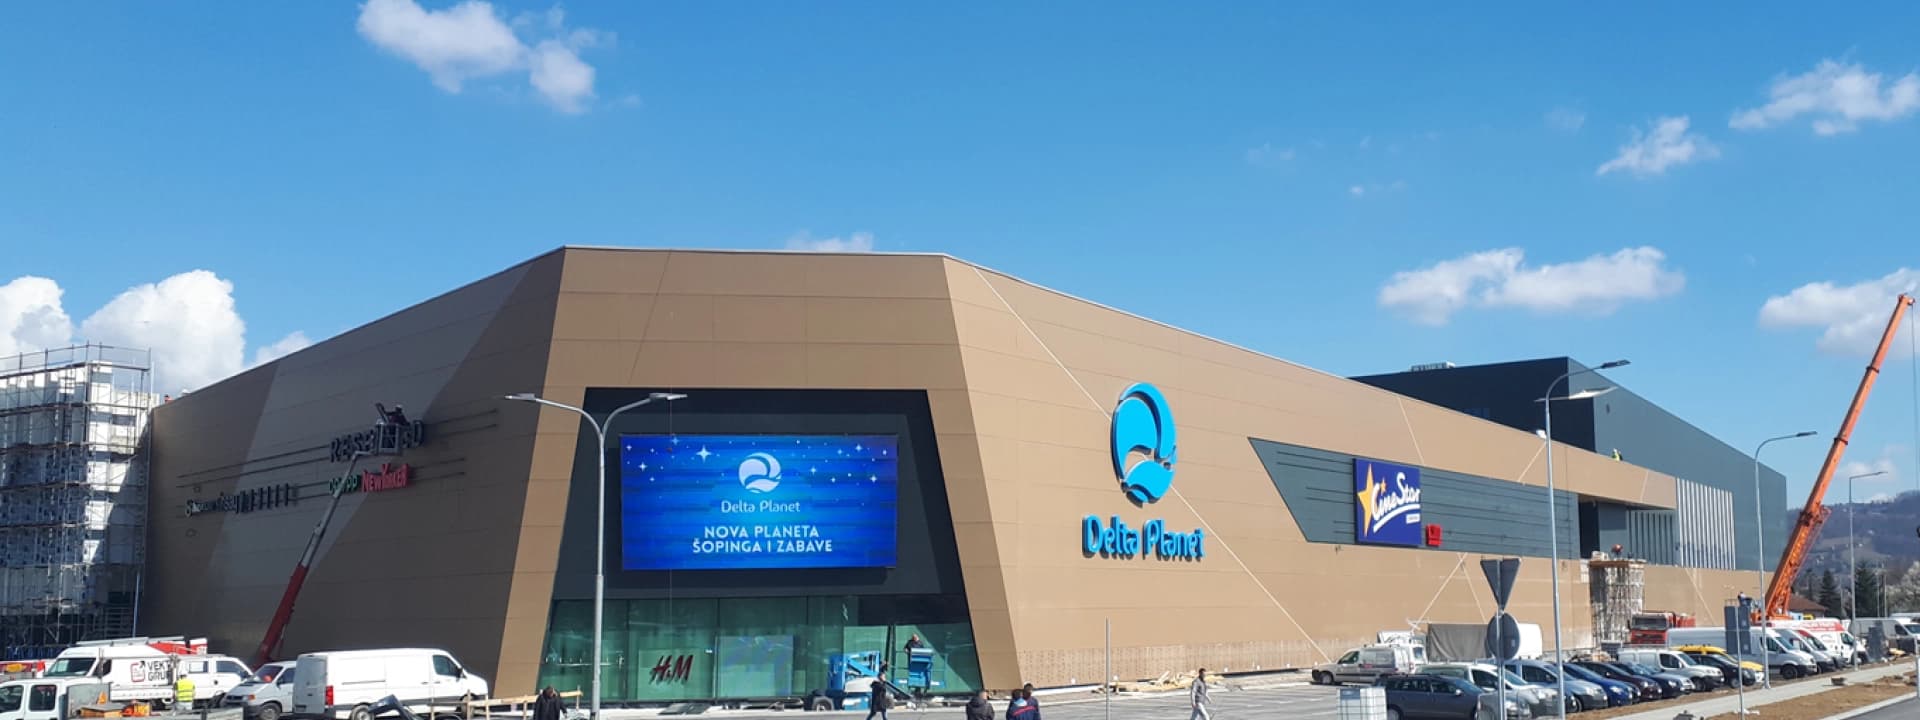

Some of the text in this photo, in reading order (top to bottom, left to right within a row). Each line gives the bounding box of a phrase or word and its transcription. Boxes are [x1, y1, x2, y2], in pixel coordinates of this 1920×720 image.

[1371, 472, 1420, 520] CineStar
[721, 501, 801, 513] Delta Planet
[704, 525, 819, 538] NOVA PLANETA
[1083, 514, 1205, 561] Delta Planet
[692, 538, 833, 553] ŠOPINGA I ZABAVE
[650, 654, 694, 682] H&M
